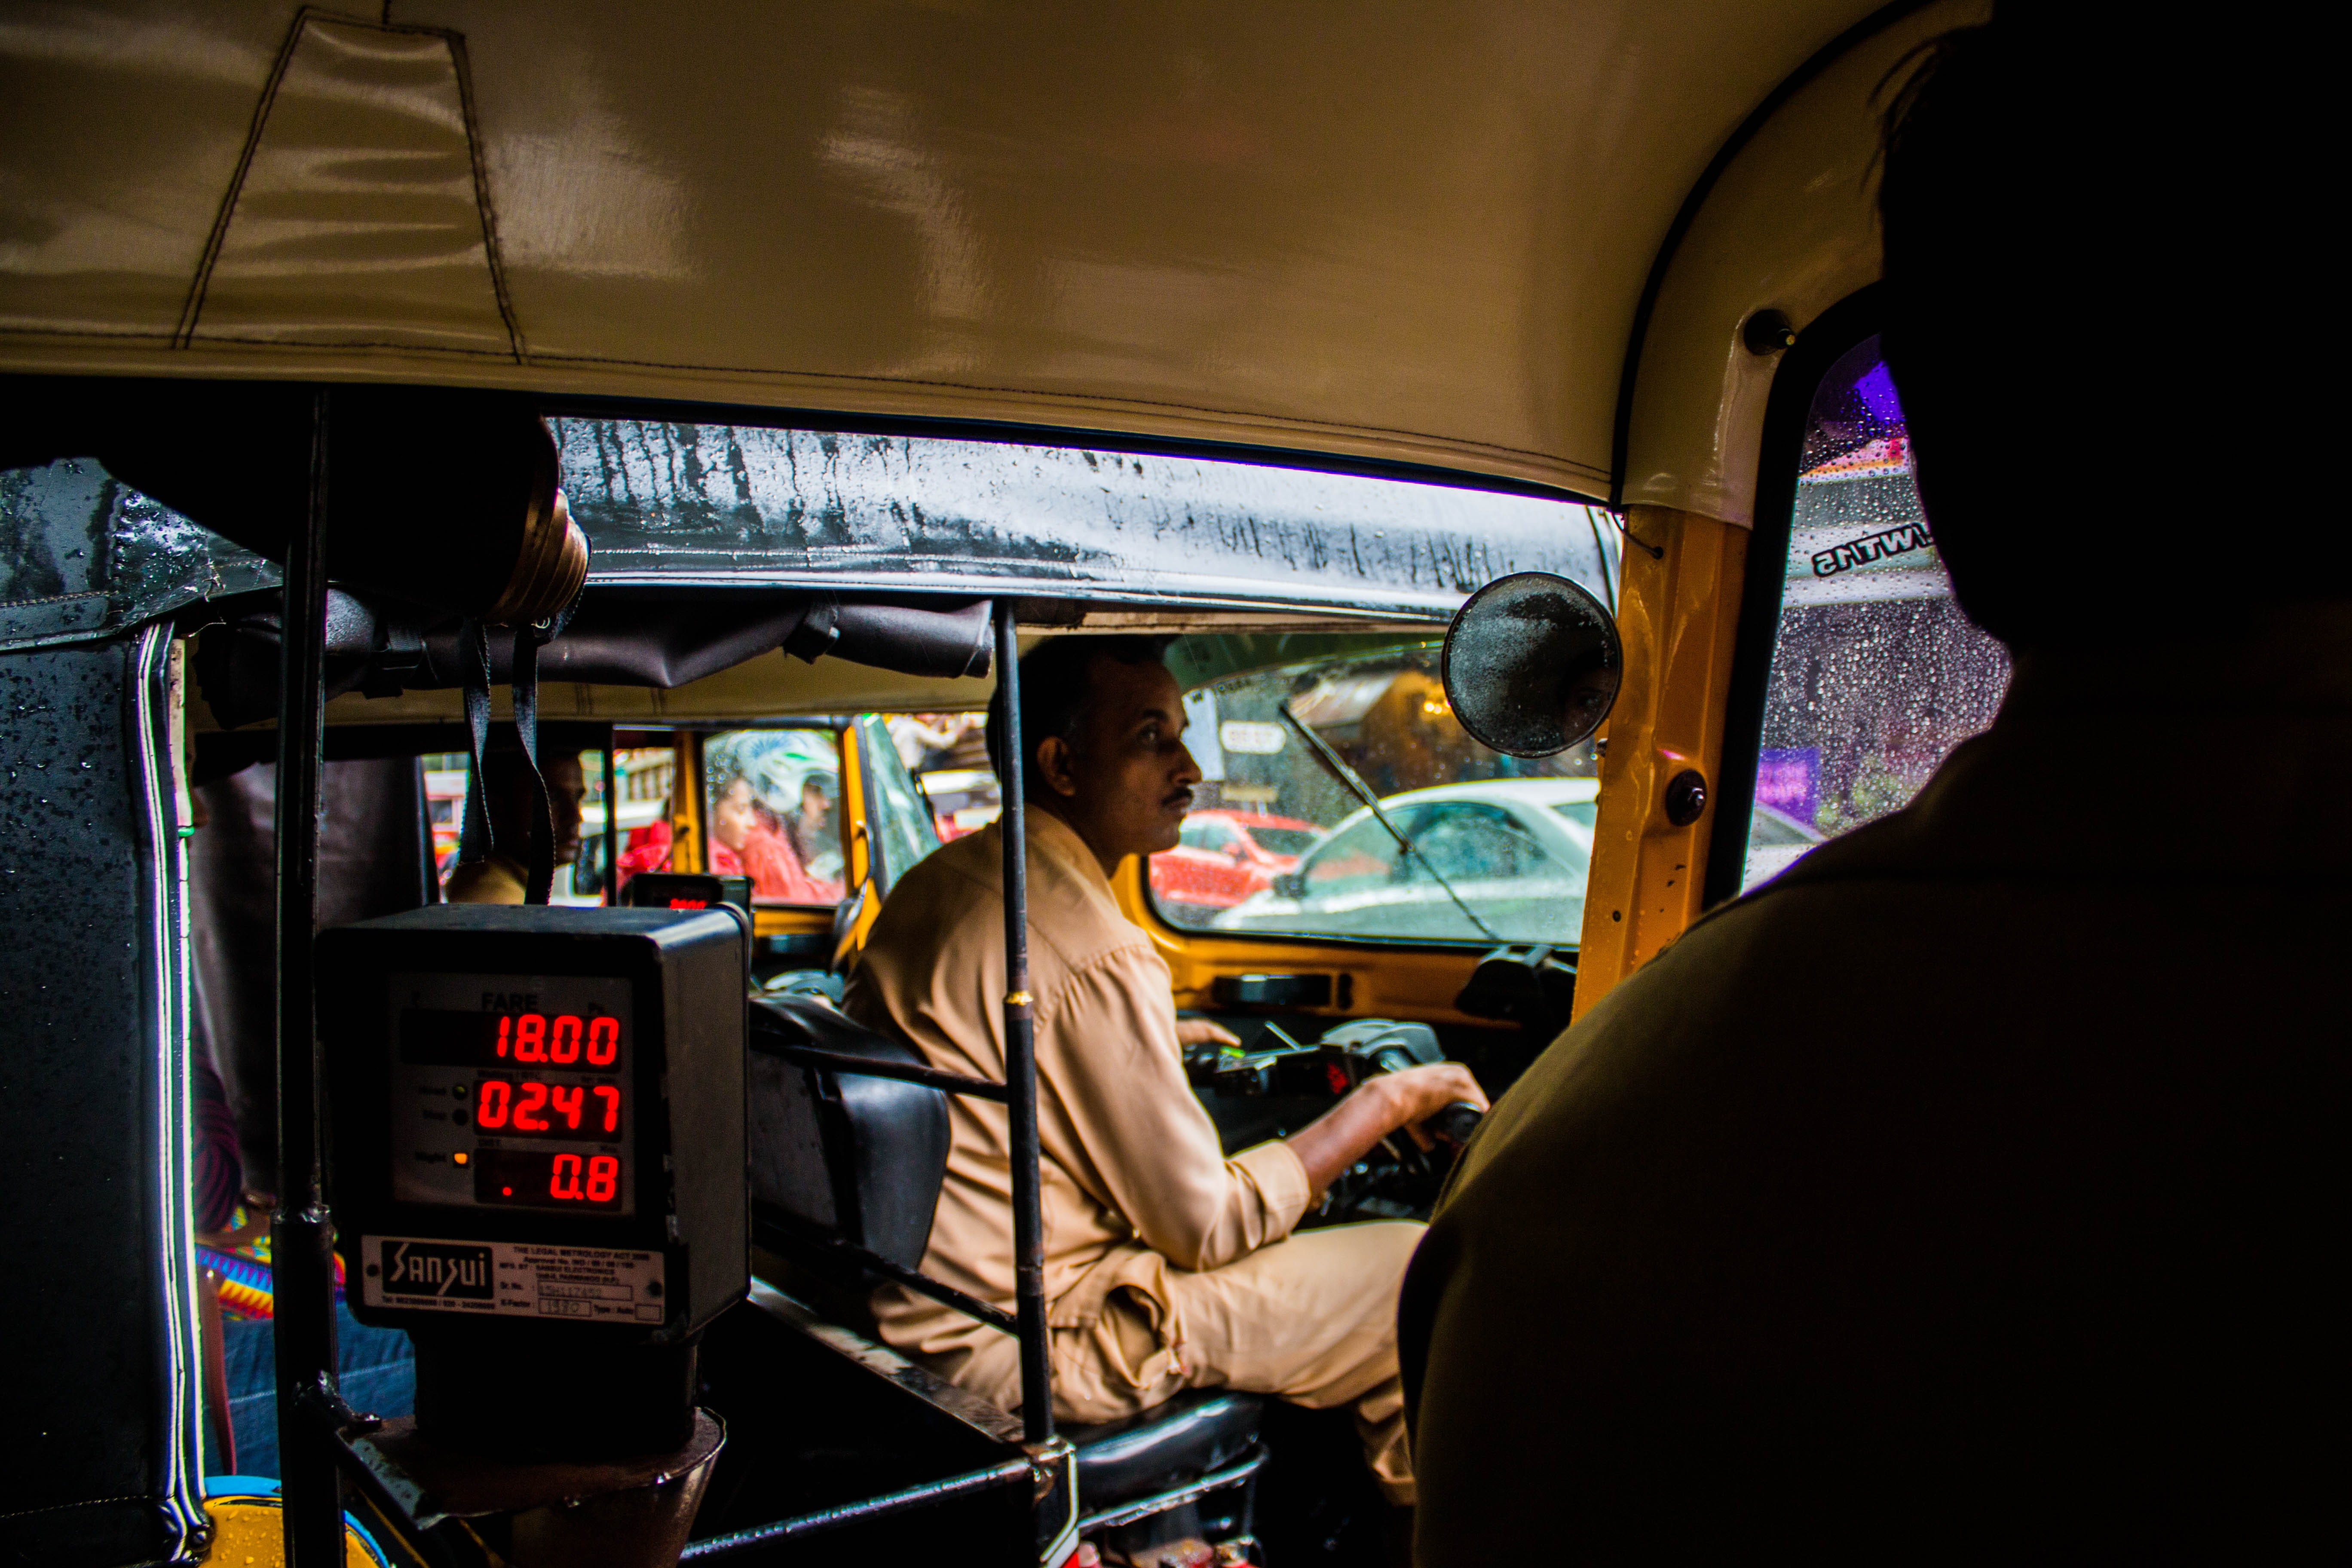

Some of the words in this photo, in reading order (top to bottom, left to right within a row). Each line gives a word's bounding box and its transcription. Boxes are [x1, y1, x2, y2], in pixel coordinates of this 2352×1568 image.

[481, 992, 538, 1013] FARE
[497, 1014, 619, 1065] 18.00
[550, 1154, 619, 1201] 0.8
[513, 1246, 528, 1254] THE
[530, 1247, 557, 1256] LEGAL
[560, 1249, 612, 1259] METROLOGY
